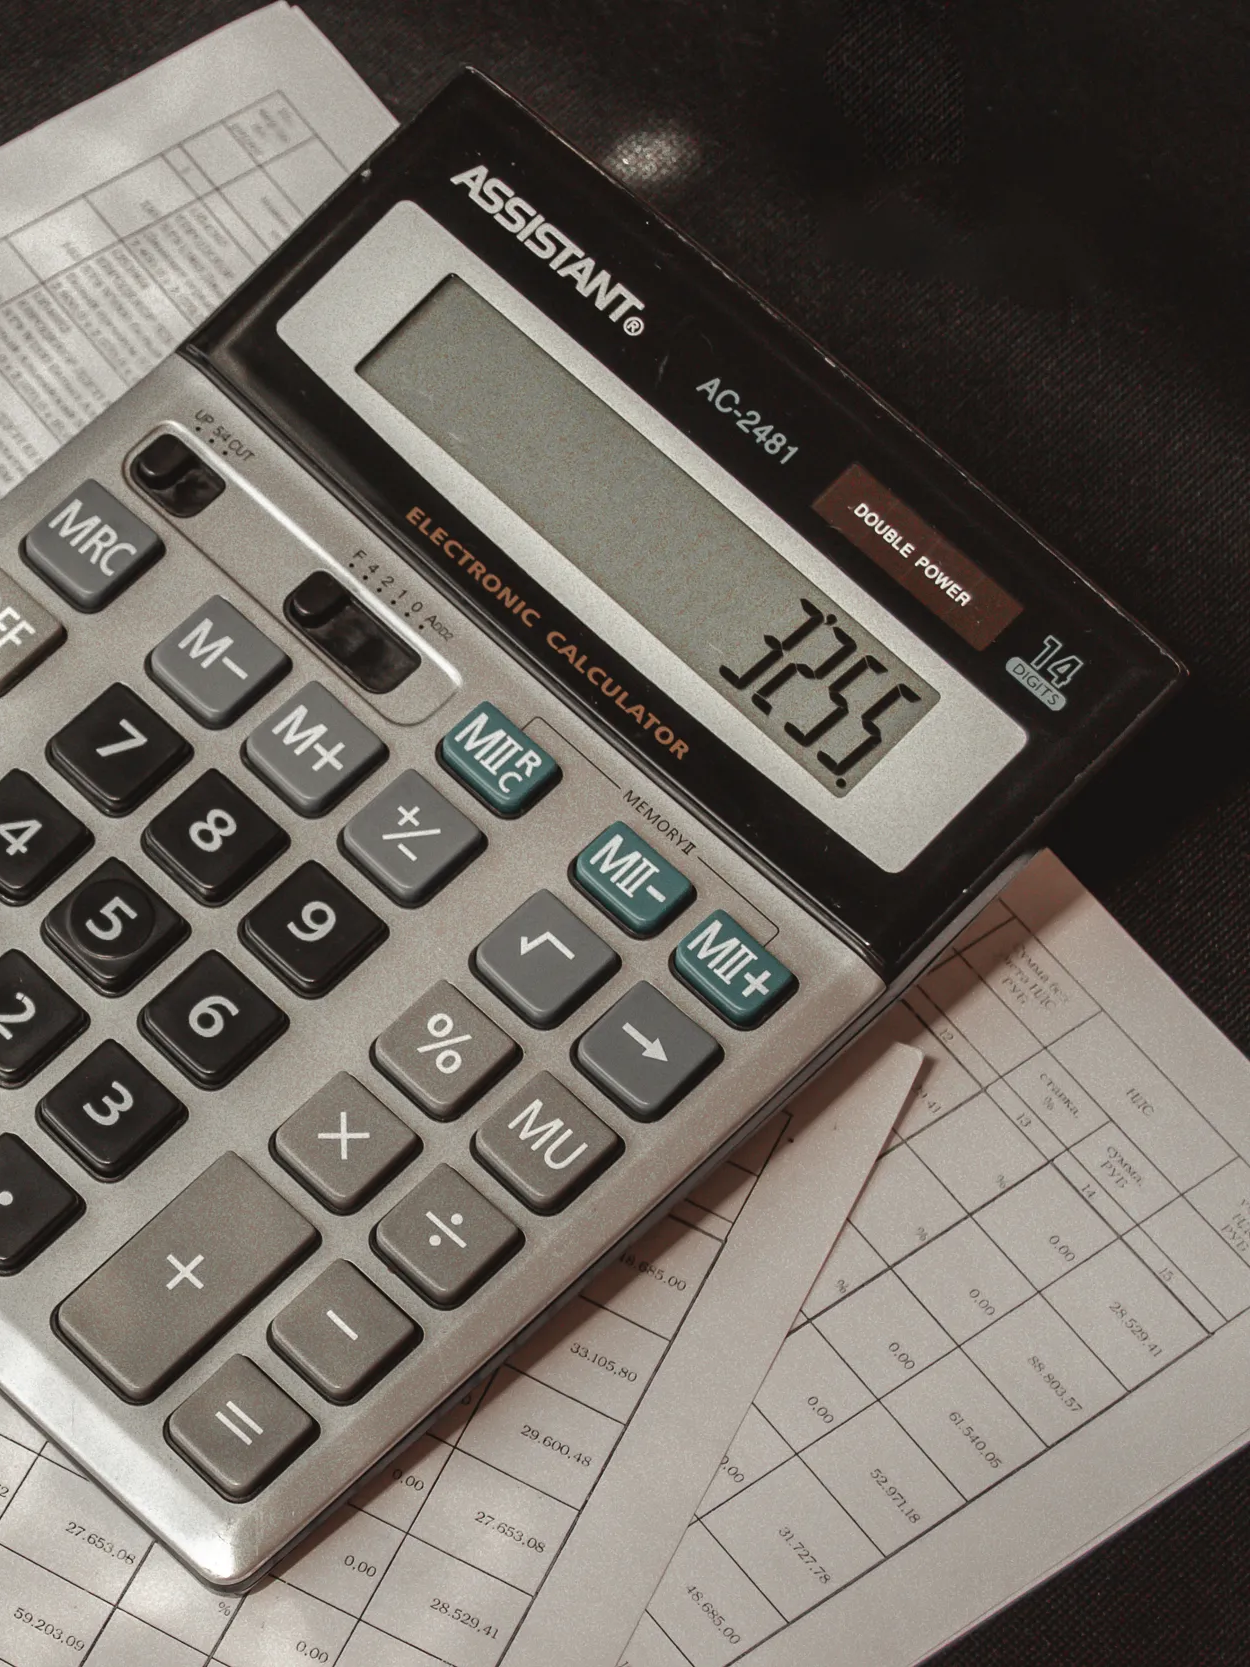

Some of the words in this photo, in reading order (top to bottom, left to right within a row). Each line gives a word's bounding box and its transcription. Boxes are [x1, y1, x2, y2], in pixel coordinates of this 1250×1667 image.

[695, 377, 799, 465] AC-2481
[227, 438, 256, 462] CUT
[49, 498, 138, 577] MRC
[853, 502, 916, 559] DOUBLE
[913, 555, 972, 607] POWER
[405, 506, 541, 628] ELECTRONIC
[545, 630, 689, 760] CALCULATOR
[1011, 662, 1060, 706] DIGITS
[1029, 634, 1084, 689] 14
[95, 718, 148, 757] 7
[188, 808, 237, 852] 8
[84, 895, 138, 941] 5
[286, 900, 336, 942] 9
[188, 994, 240, 1038] 6
[82, 1080, 134, 1126] 3
[1125, 1087, 1155, 1116] НДС
[507, 1099, 590, 1171] MU
